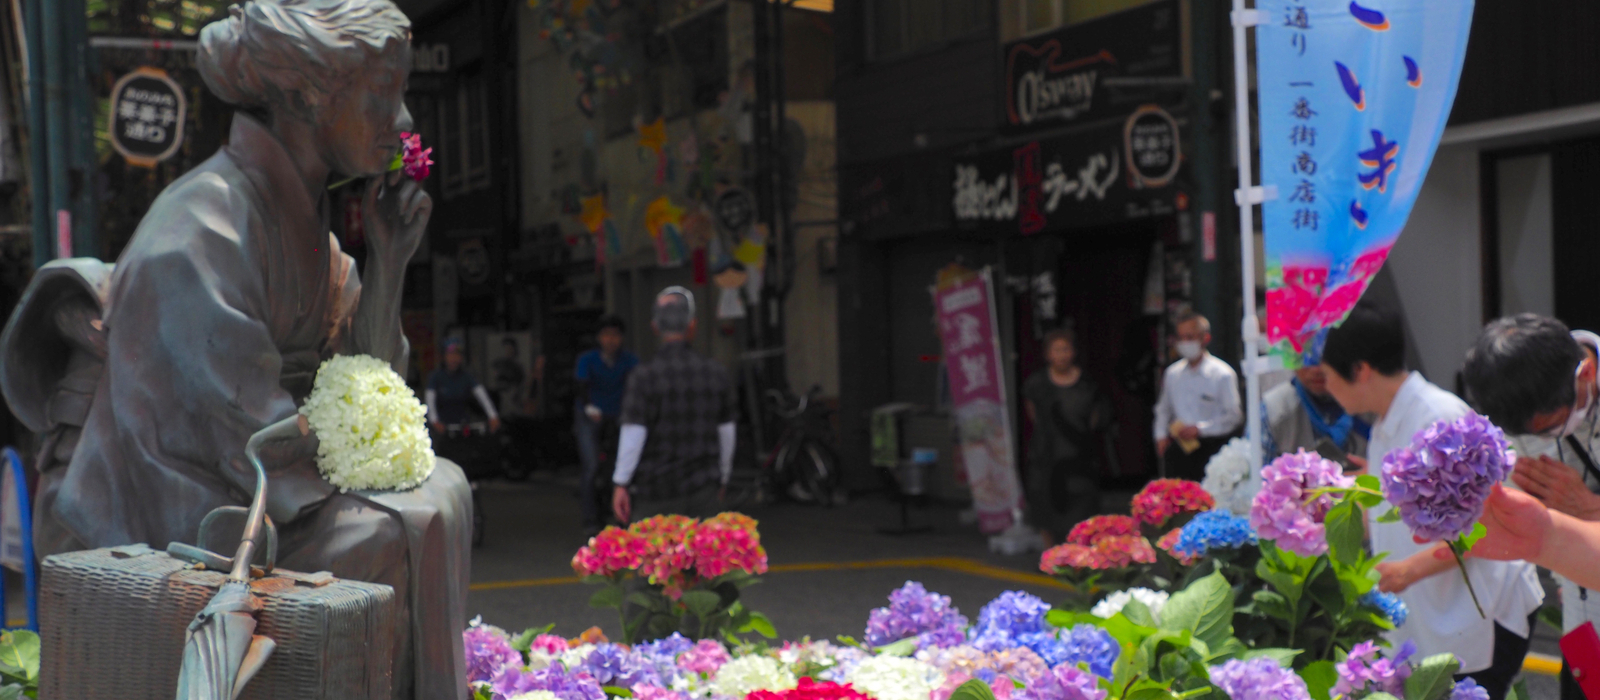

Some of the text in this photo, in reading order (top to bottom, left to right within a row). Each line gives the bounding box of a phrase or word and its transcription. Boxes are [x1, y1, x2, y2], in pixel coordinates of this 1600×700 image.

[1041, 147, 1119, 212] ラーメン
[1284, 0, 1320, 232] 通り 一番街商店街
